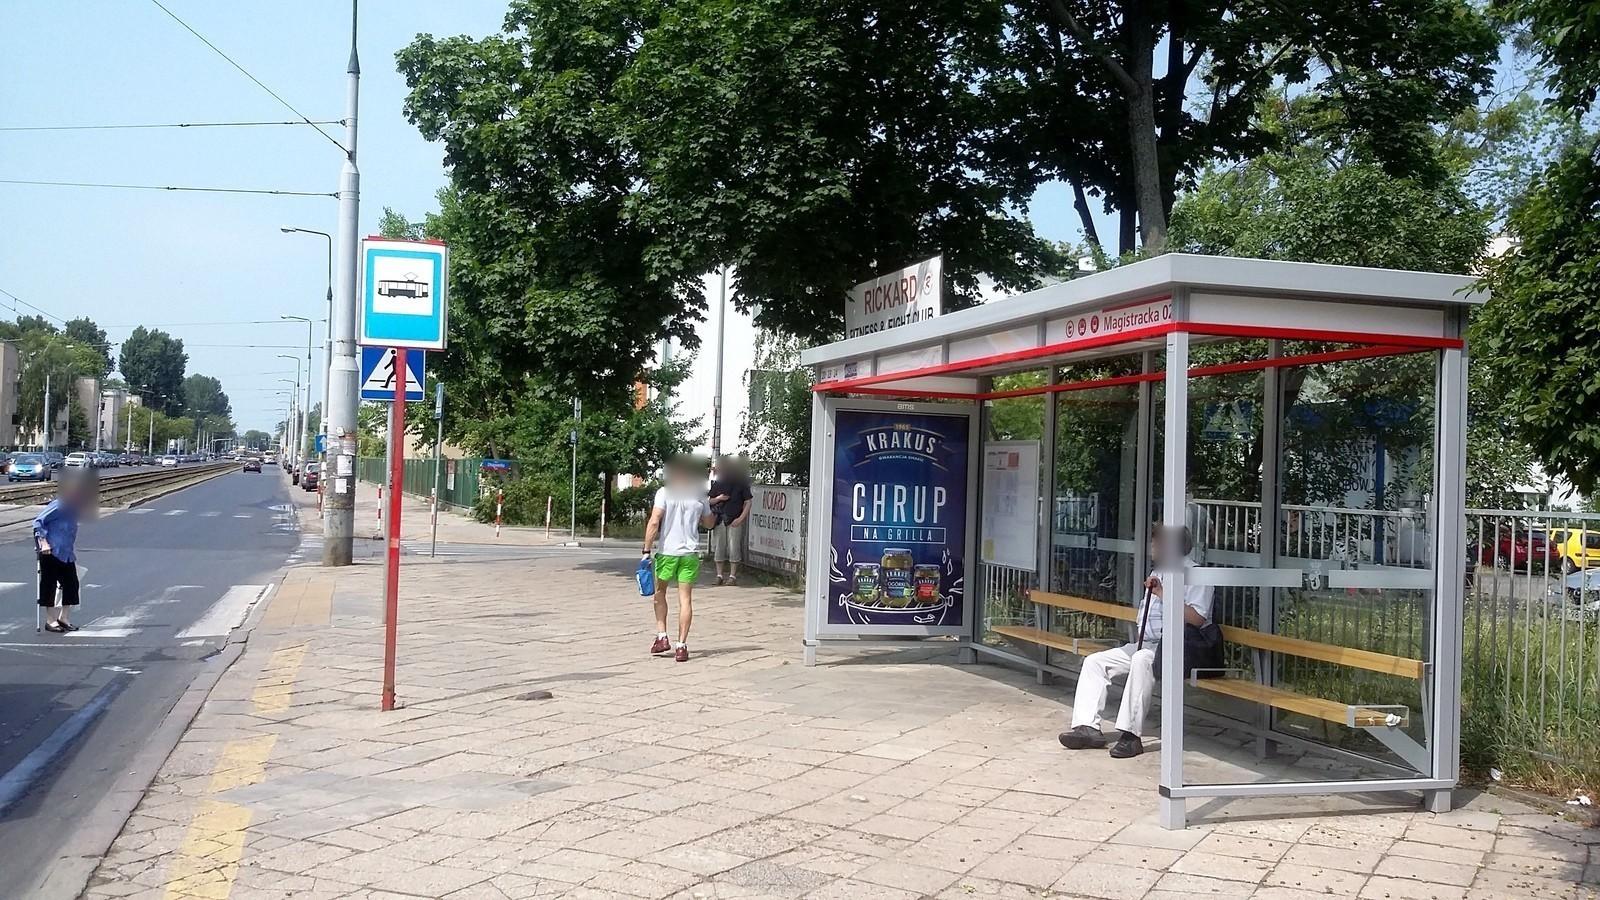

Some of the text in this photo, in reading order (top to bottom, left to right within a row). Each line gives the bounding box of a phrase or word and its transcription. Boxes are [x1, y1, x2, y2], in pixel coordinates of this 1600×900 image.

[864, 274, 917, 315] RICKARD
[1104, 308, 1159, 331] Magistracka
[897, 403, 915, 411] ams
[866, 431, 936, 454] KRAKUS
[853, 483, 946, 523] CHRUP
[863, 527, 932, 542] NA GRILLA
